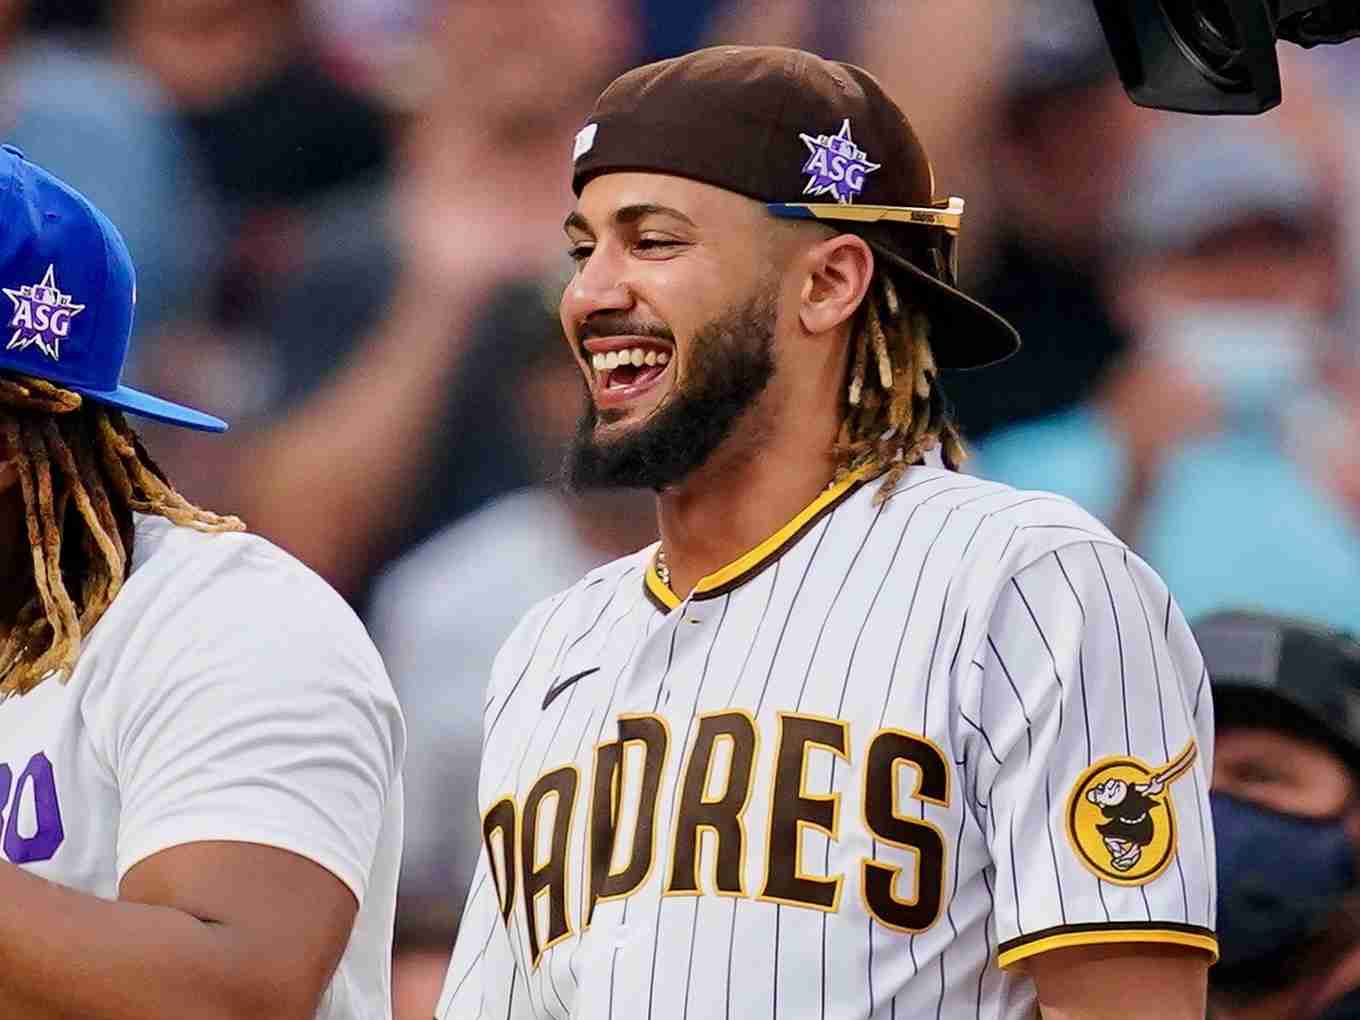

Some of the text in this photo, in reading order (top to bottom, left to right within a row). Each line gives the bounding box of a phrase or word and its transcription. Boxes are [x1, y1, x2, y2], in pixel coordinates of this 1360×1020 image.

[806, 147, 865, 191] ASG
[11, 298, 71, 337] ASG
[483, 710, 950, 974] PADRES
